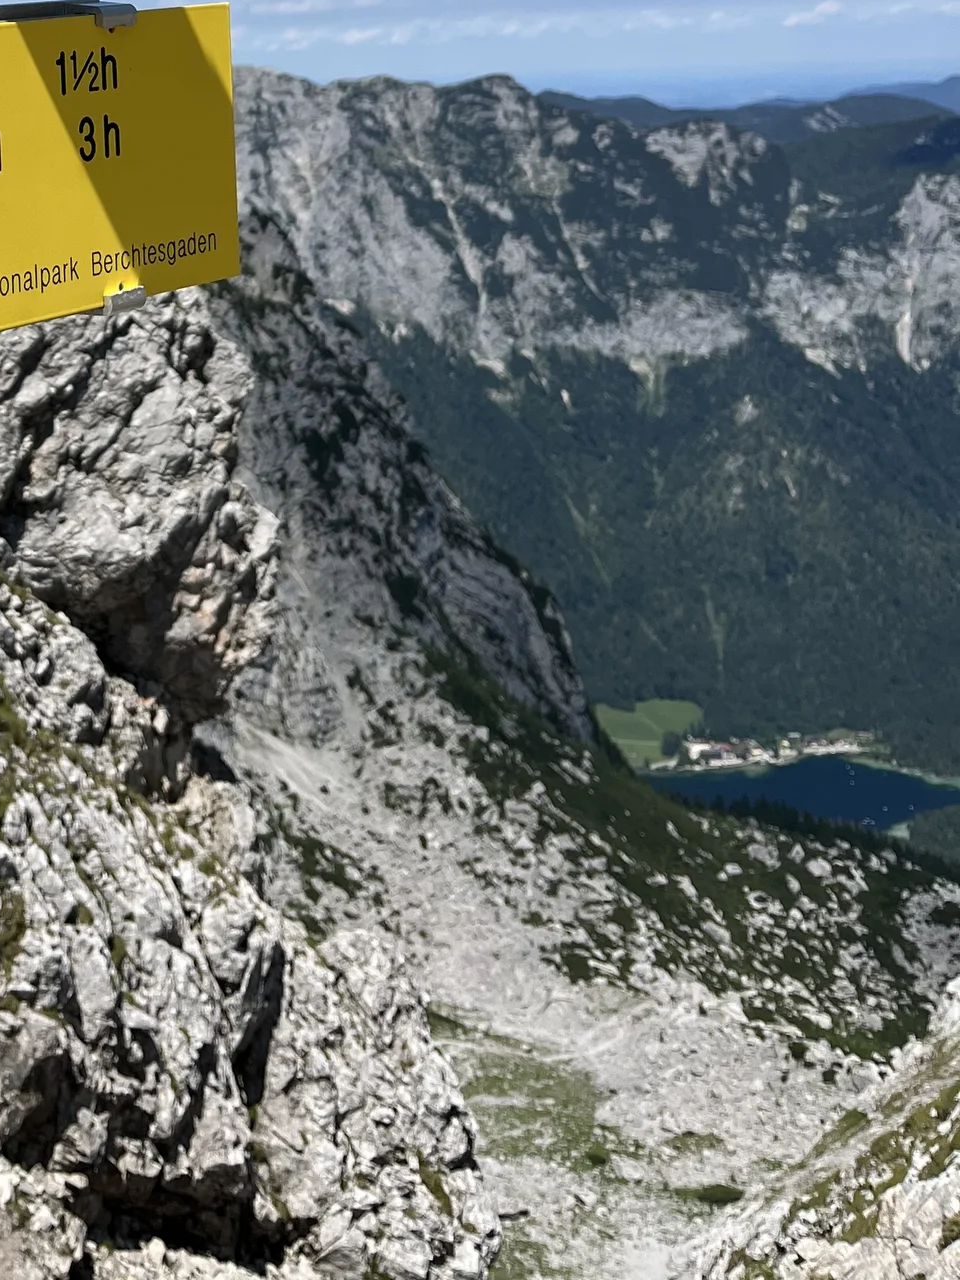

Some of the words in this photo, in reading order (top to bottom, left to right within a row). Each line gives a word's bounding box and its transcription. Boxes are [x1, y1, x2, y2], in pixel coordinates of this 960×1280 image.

[79, 116, 96, 161] 3
[104, 114, 120, 158] h
[91, 230, 217, 276] Berchtesgaden
